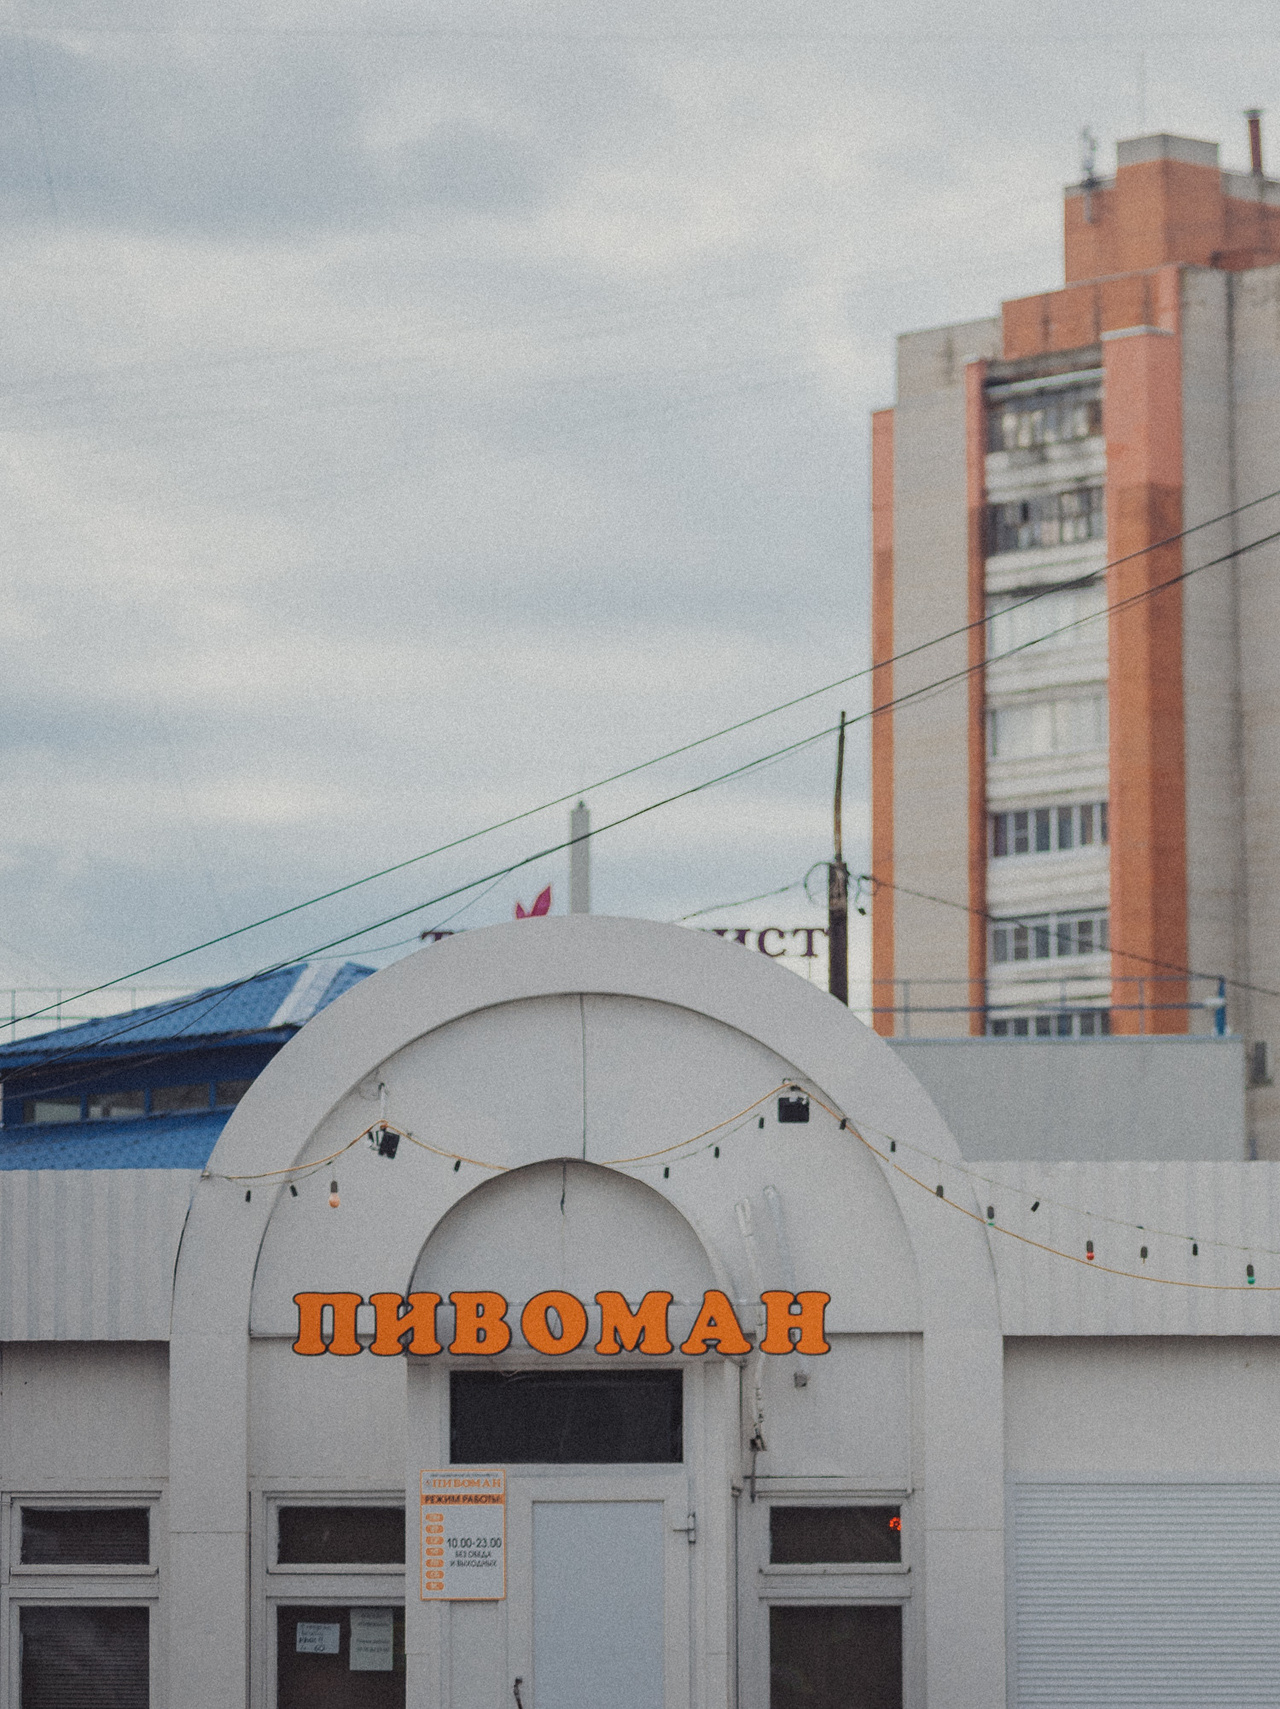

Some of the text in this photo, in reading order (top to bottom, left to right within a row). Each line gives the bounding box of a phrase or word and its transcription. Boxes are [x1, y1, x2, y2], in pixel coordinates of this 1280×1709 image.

[292, 1290, 832, 1356] ПИВОМАН
[432, 1479, 501, 1488] ПИВОМАН
[425, 1495, 460, 1504] РЕЖИМ
[447, 1537, 502, 1548] 10.00-23.00
